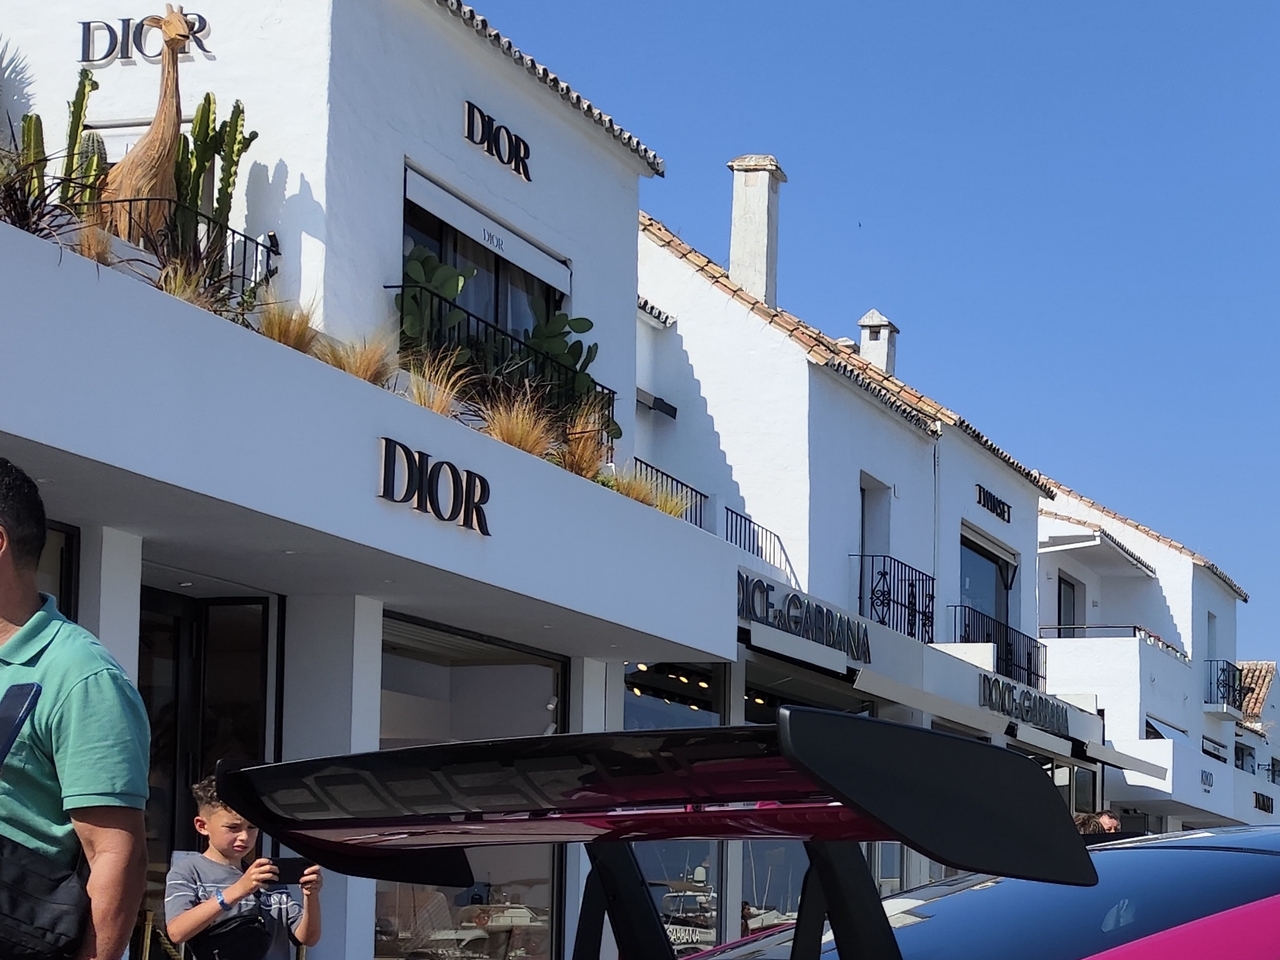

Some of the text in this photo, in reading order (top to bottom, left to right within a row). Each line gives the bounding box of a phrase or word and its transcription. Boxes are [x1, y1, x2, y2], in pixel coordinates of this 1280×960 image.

[76, 13, 212, 62] DIOR
[464, 101, 533, 182] DIOR
[482, 228, 505, 252] DIOR
[378, 436, 493, 536] DIOR
[975, 484, 1012, 524] TWINSET
[785, 593, 871, 664] GABBANA
[979, 673, 1016, 718] DOLCE
